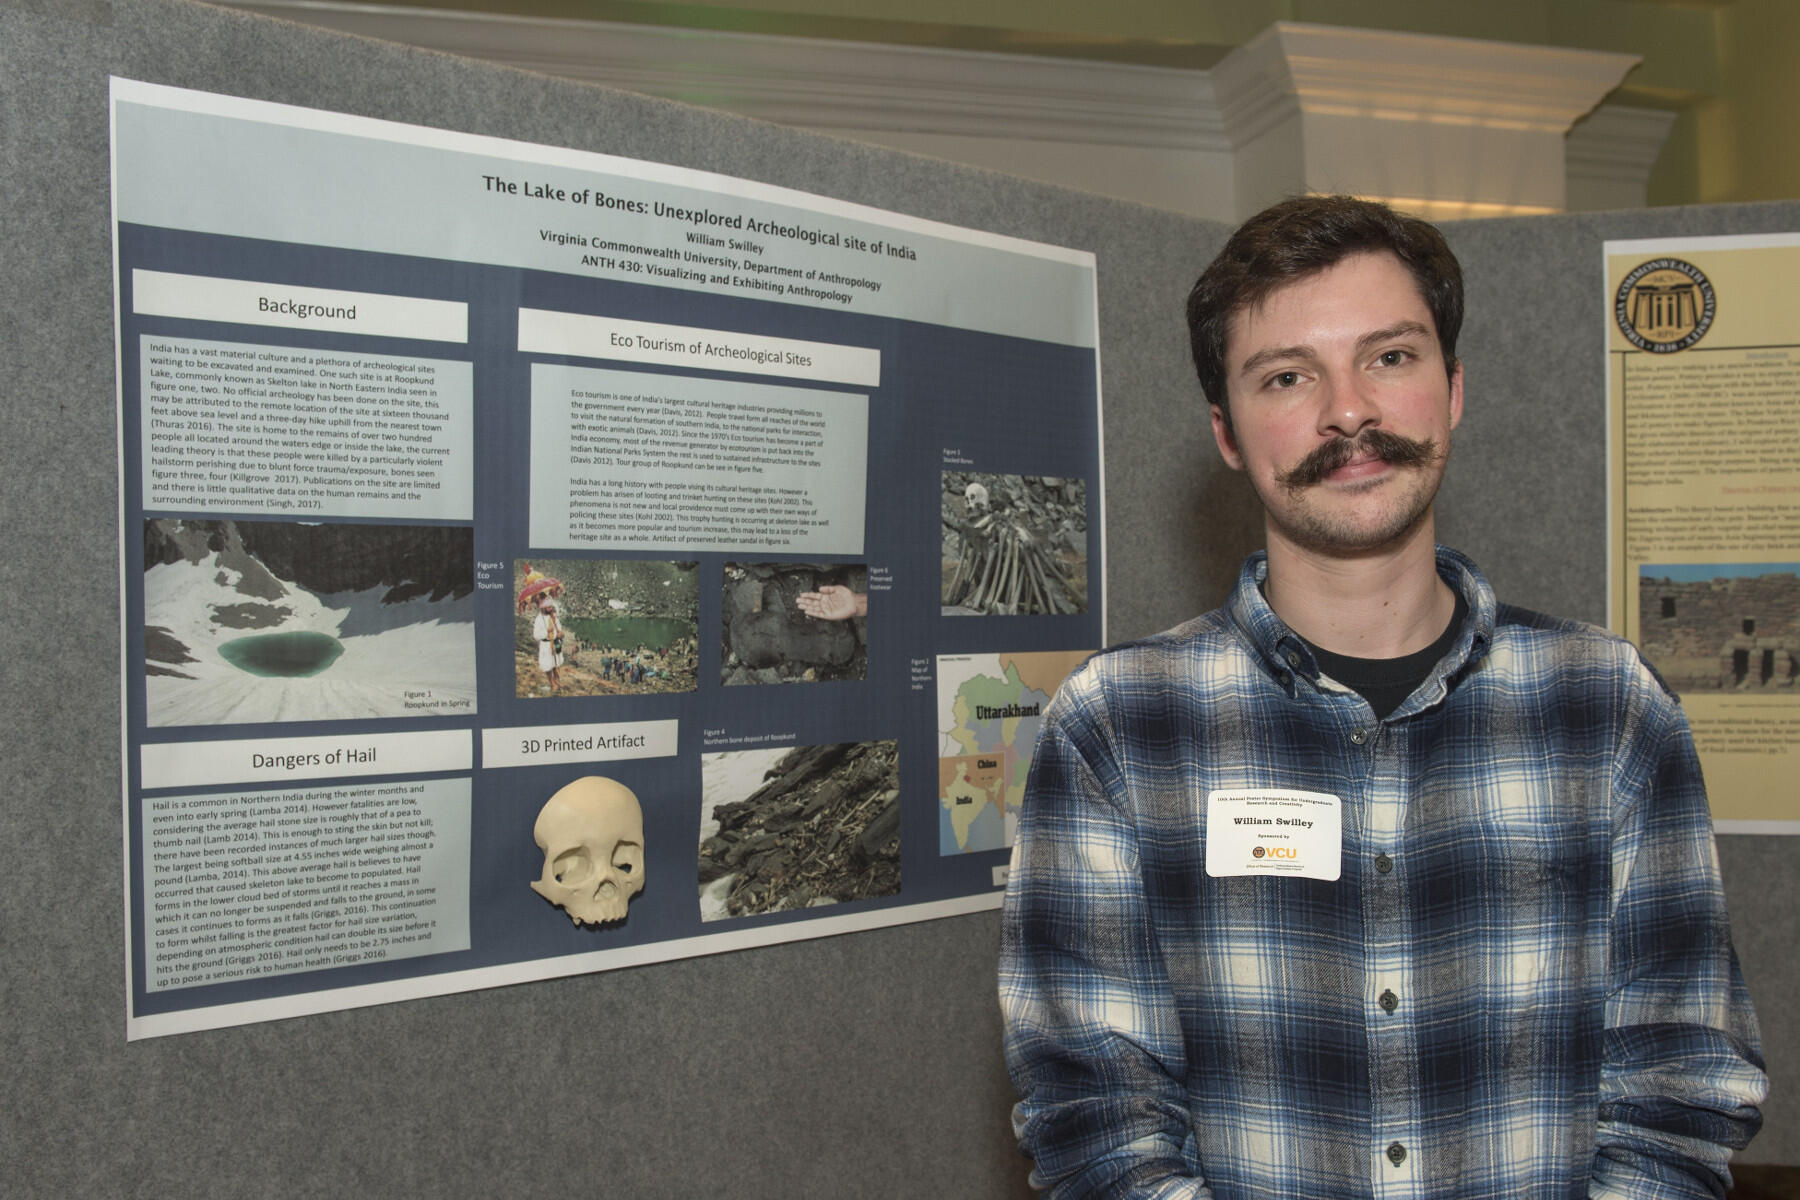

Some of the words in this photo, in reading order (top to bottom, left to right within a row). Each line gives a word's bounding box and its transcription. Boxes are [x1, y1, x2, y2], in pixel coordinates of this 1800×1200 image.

[481, 175, 517, 194] The
[524, 181, 565, 201] Lake
[571, 188, 590, 204] of
[595, 191, 648, 214] Bones:
[653, 201, 742, 229] Unexplored
[746, 217, 839, 246] Archeological
[844, 235, 866, 251] site
[870, 240, 882, 254] of
[886, 243, 916, 260] India
[686, 231, 725, 247] William
[728, 238, 764, 255] Swilley
[539, 229, 587, 246] Virginia
[591, 236, 680, 260] Commonwealth
[683, 250, 740, 270] University,
[743, 259, 802, 278] Department
[805, 269, 816, 279] of
[818, 271, 881, 291] Anthropology
[581, 254, 615, 269] ANTH
[618, 259, 642, 272] 430:
[645, 263, 706, 284] Visualizing
[709, 274, 729, 285] and
[732, 275, 784, 295] Exhibiting
[786, 284, 852, 304] Anthropology
[259, 297, 355, 319] Background
[1619, 259, 1705, 301] COMMONWEALTH
[1685, 282, 1714, 344] UNIVERSITY
[149, 342, 172, 353] India
[174, 344, 190, 354] has
[199, 346, 218, 356] vast
[219, 348, 256, 359] material
[258, 351, 288, 362] culture
[289, 354, 307, 363] and
[315, 356, 351, 369] plethora
[352, 359, 361, 368] of
[362, 359, 415, 374] archeological
[417, 364, 435, 373] sites
[611, 333, 633, 347] Eco
[636, 336, 685, 352] Tourism
[690, 342, 701, 354] of
[705, 344, 782, 364] Archeological
[786, 352, 811, 366] Sites
[149, 355, 183, 369] waiting
[184, 358, 195, 367] to
[196, 359, 209, 368] be
[209, 360, 254, 372] excavated
[255, 363, 272, 373] and
[273, 365, 316, 376] examined.
[319, 368, 337, 378] One
[338, 369, 358, 379] such
[359, 371, 374, 381] site
[376, 372, 383, 381] is
[384, 373, 392, 382] at
[394, 374, 434, 387] Roopkund
[615, 458, 631, 466] Tour
[652, 460, 660, 468] of
[477, 561, 498, 571] Figure
[404, 690, 425, 699] Figure
[404, 700, 439, 709] Roopkund
[449, 699, 471, 708] Spring
[976, 702, 1040, 720] Uttarakhand
[704, 729, 720, 737] Figure
[522, 740, 540, 753] 3D
[545, 737, 592, 752] Printed
[597, 734, 645, 748] Artifact
[253, 754, 320, 769] Dangers
[325, 749, 341, 764] of
[347, 748, 376, 763] Hail
[977, 759, 997, 769] China
[152, 799, 169, 809] Hail
[171, 799, 179, 808] is
[188, 798, 227, 807] common
[229, 796, 238, 805] in
[240, 793, 280, 804] Northern
[282, 792, 303, 802] India
[304, 791, 332, 803] during
[333, 790, 348, 799] the
[349, 788, 375, 798] winter
[377, 786, 408, 796] months
[409, 786, 424, 794] and
[956, 796, 973, 805] India
[1299, 798, 1333, 806] Undergraduate
[1234, 817, 1272, 825] William
[1276, 818, 1314, 828] Swilley
[1266, 847, 1297, 858] VCU
[156, 963, 173, 974] hits
[174, 961, 190, 971] the
[191, 957, 223, 972] ground
[224, 953, 256, 967] (Griggs
[286, 947, 303, 957] Hail
[304, 945, 322, 957] only
[323, 941, 348, 953] needs
[349, 940, 359, 949] to
[359, 939, 371, 948] be
[391, 933, 416, 944] inches
[417, 931, 431, 941] and
